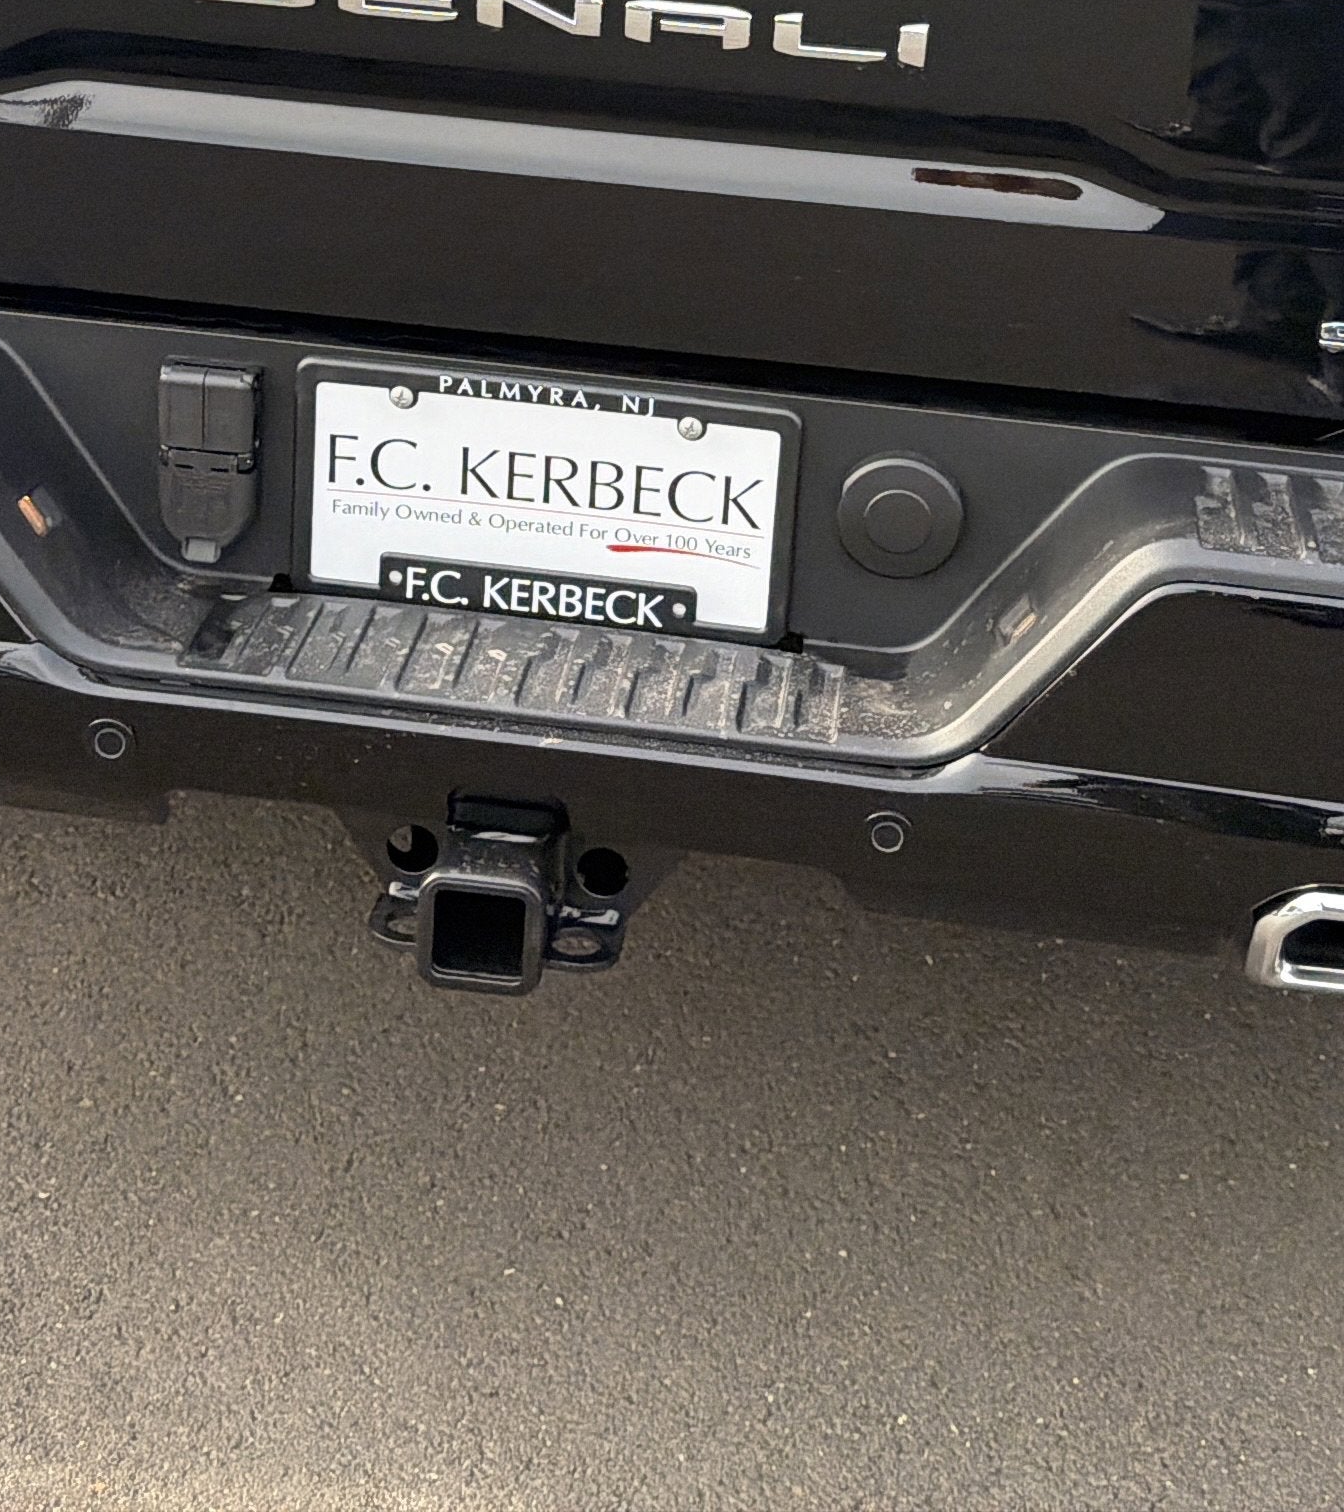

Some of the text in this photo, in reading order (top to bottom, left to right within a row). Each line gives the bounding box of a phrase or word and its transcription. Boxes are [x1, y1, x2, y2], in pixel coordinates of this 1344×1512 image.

[438, 374, 656, 418] PALMYRA, NJ
[327, 433, 765, 531] F.C. KERBECK
[331, 498, 752, 560] Family Owned & Operated For Over 100 Years
[404, 566, 666, 629] F.C. KERBECK
